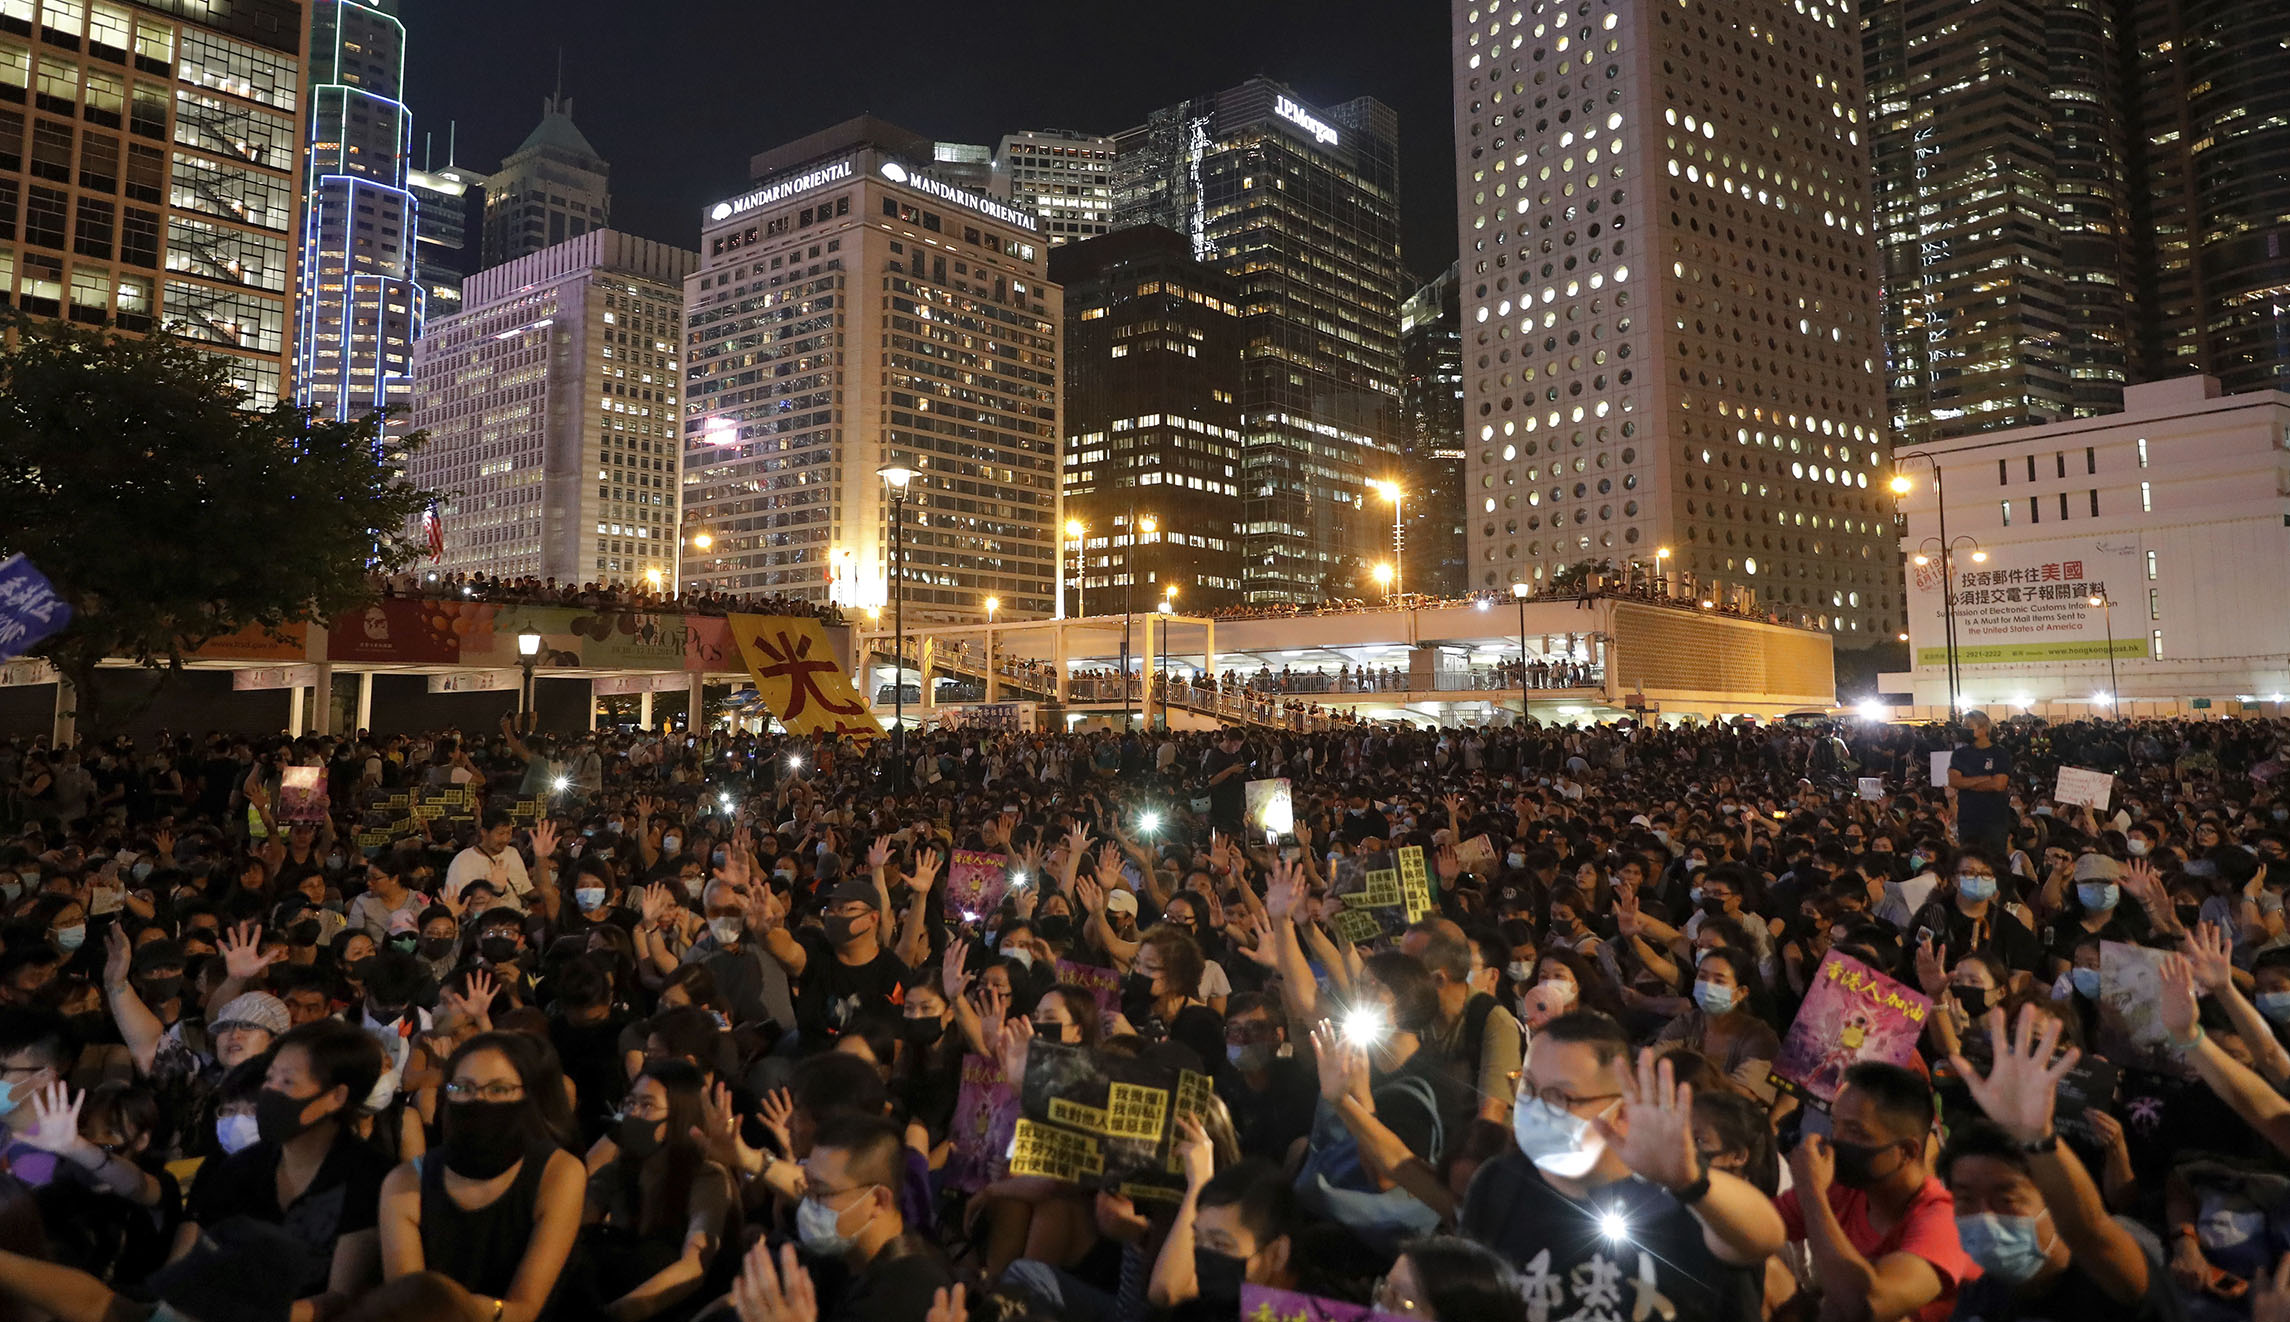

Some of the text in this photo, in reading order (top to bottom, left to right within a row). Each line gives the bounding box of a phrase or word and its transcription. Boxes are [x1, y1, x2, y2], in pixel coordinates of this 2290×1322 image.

[1274, 94, 1338, 146] J.P.Morgan
[733, 161, 853, 214] MANDARIN ORIENTAL
[909, 172, 1038, 231] MANDARIN ORIENTAL
[1914, 555, 1946, 578] 2019
[1962, 560, 2083, 590] 投寄郵件往美國
[1980, 607, 1988, 615] of
[1989, 604, 2027, 614] Electronic
[2030, 602, 2065, 612] Customs
[1981, 616, 1998, 624] Must
[2000, 615, 2011, 623] for
[2014, 614, 2030, 622] Mail
[2032, 613, 2055, 621] Items
[2057, 612, 2075, 620] Sent
[2077, 612, 2086, 620] to
[1968, 622, 2083, 634] the United States of America
[1966, 650, 2002, 658] 2921-2222
[1826, 960, 1925, 1022] 香港人加油
